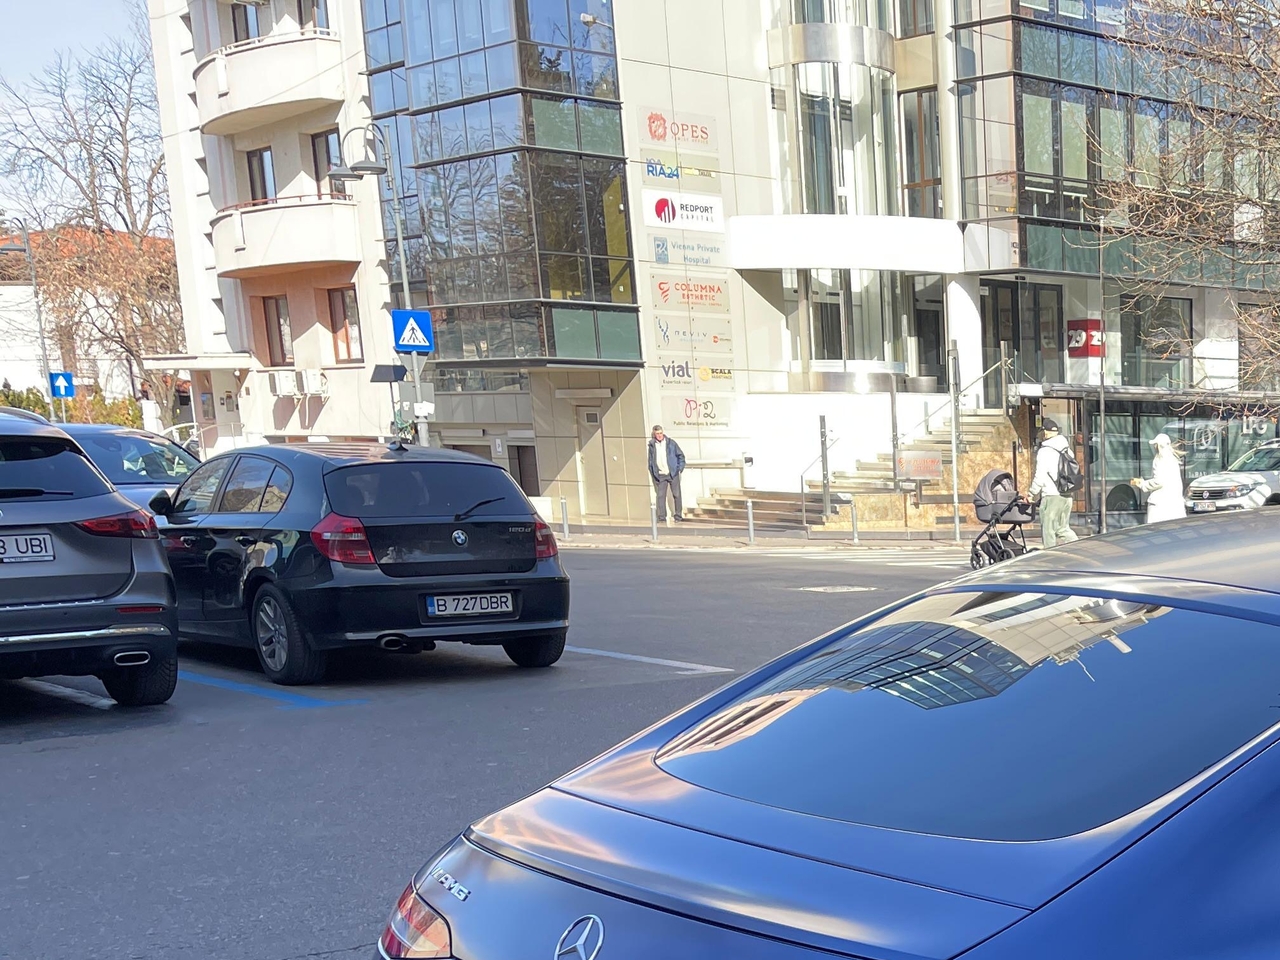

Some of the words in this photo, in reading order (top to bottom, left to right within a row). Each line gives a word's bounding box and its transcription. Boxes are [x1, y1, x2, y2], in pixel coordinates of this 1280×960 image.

[670, 122, 708, 139] OPES
[680, 203, 713, 213] REDPORT
[671, 241, 695, 251] Vienna
[697, 244, 720, 253] Private
[684, 255, 711, 265] Hospital
[674, 282, 722, 293] COLUMNA
[662, 360, 692, 378] vial
[15, 537, 48, 554] UBI
[436, 598, 448, 612] B
